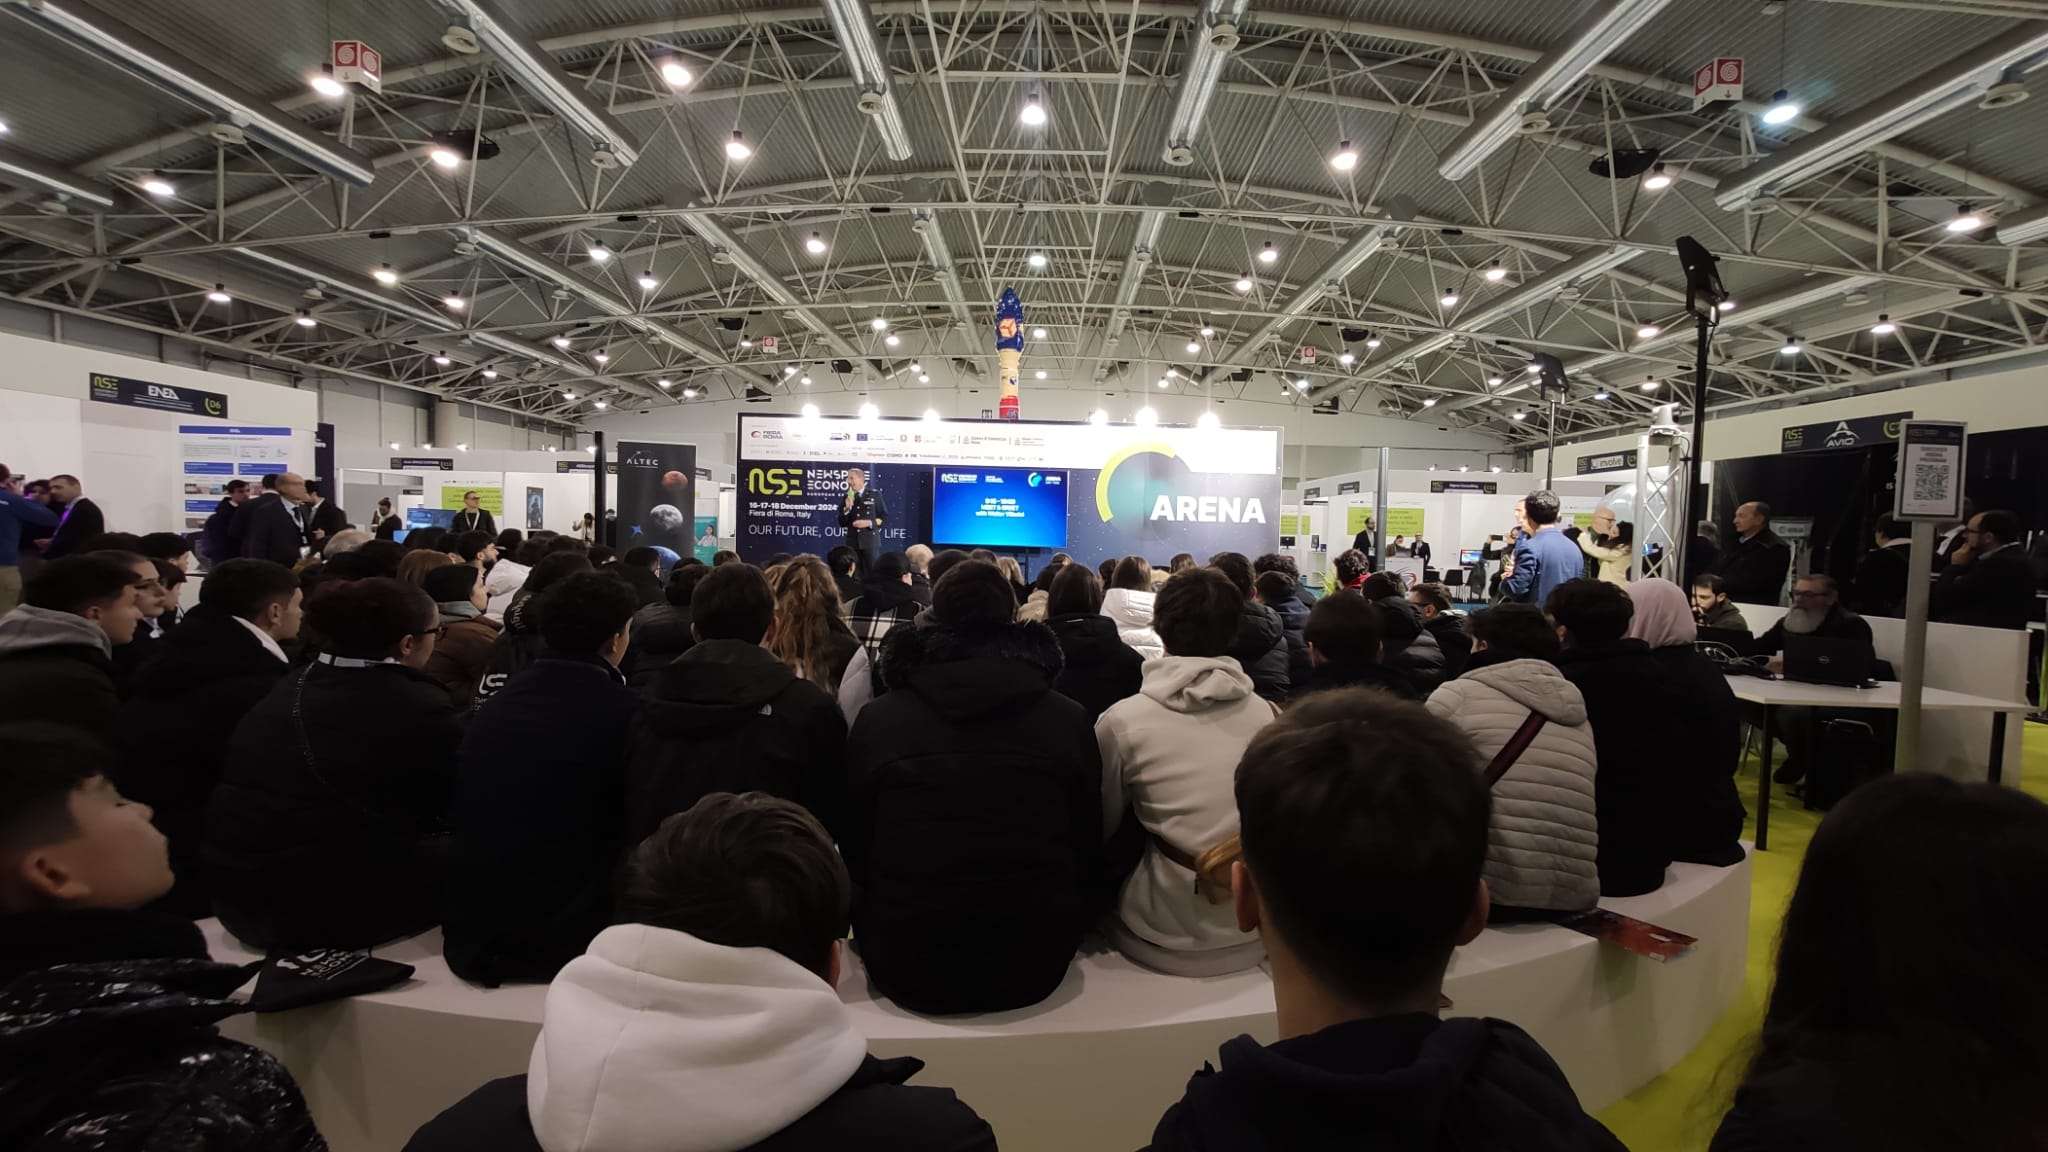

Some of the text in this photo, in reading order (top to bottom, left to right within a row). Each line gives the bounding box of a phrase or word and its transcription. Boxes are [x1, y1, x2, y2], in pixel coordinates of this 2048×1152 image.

[94, 376, 118, 390] NSE
[148, 385, 180, 400] ENEA
[209, 400, 221, 409] D6
[1826, 438, 1855, 448] AVIO
[626, 458, 659, 466] ALTEC
[807, 469, 870, 480] NEWSPE
[748, 468, 803, 496] NSE
[796, 511, 811, 519] Italy
[1150, 495, 1266, 524] ARENA
[748, 524, 772, 535] OUR
[775, 525, 822, 538] FUTURE,
[885, 528, 907, 538] LIFE
